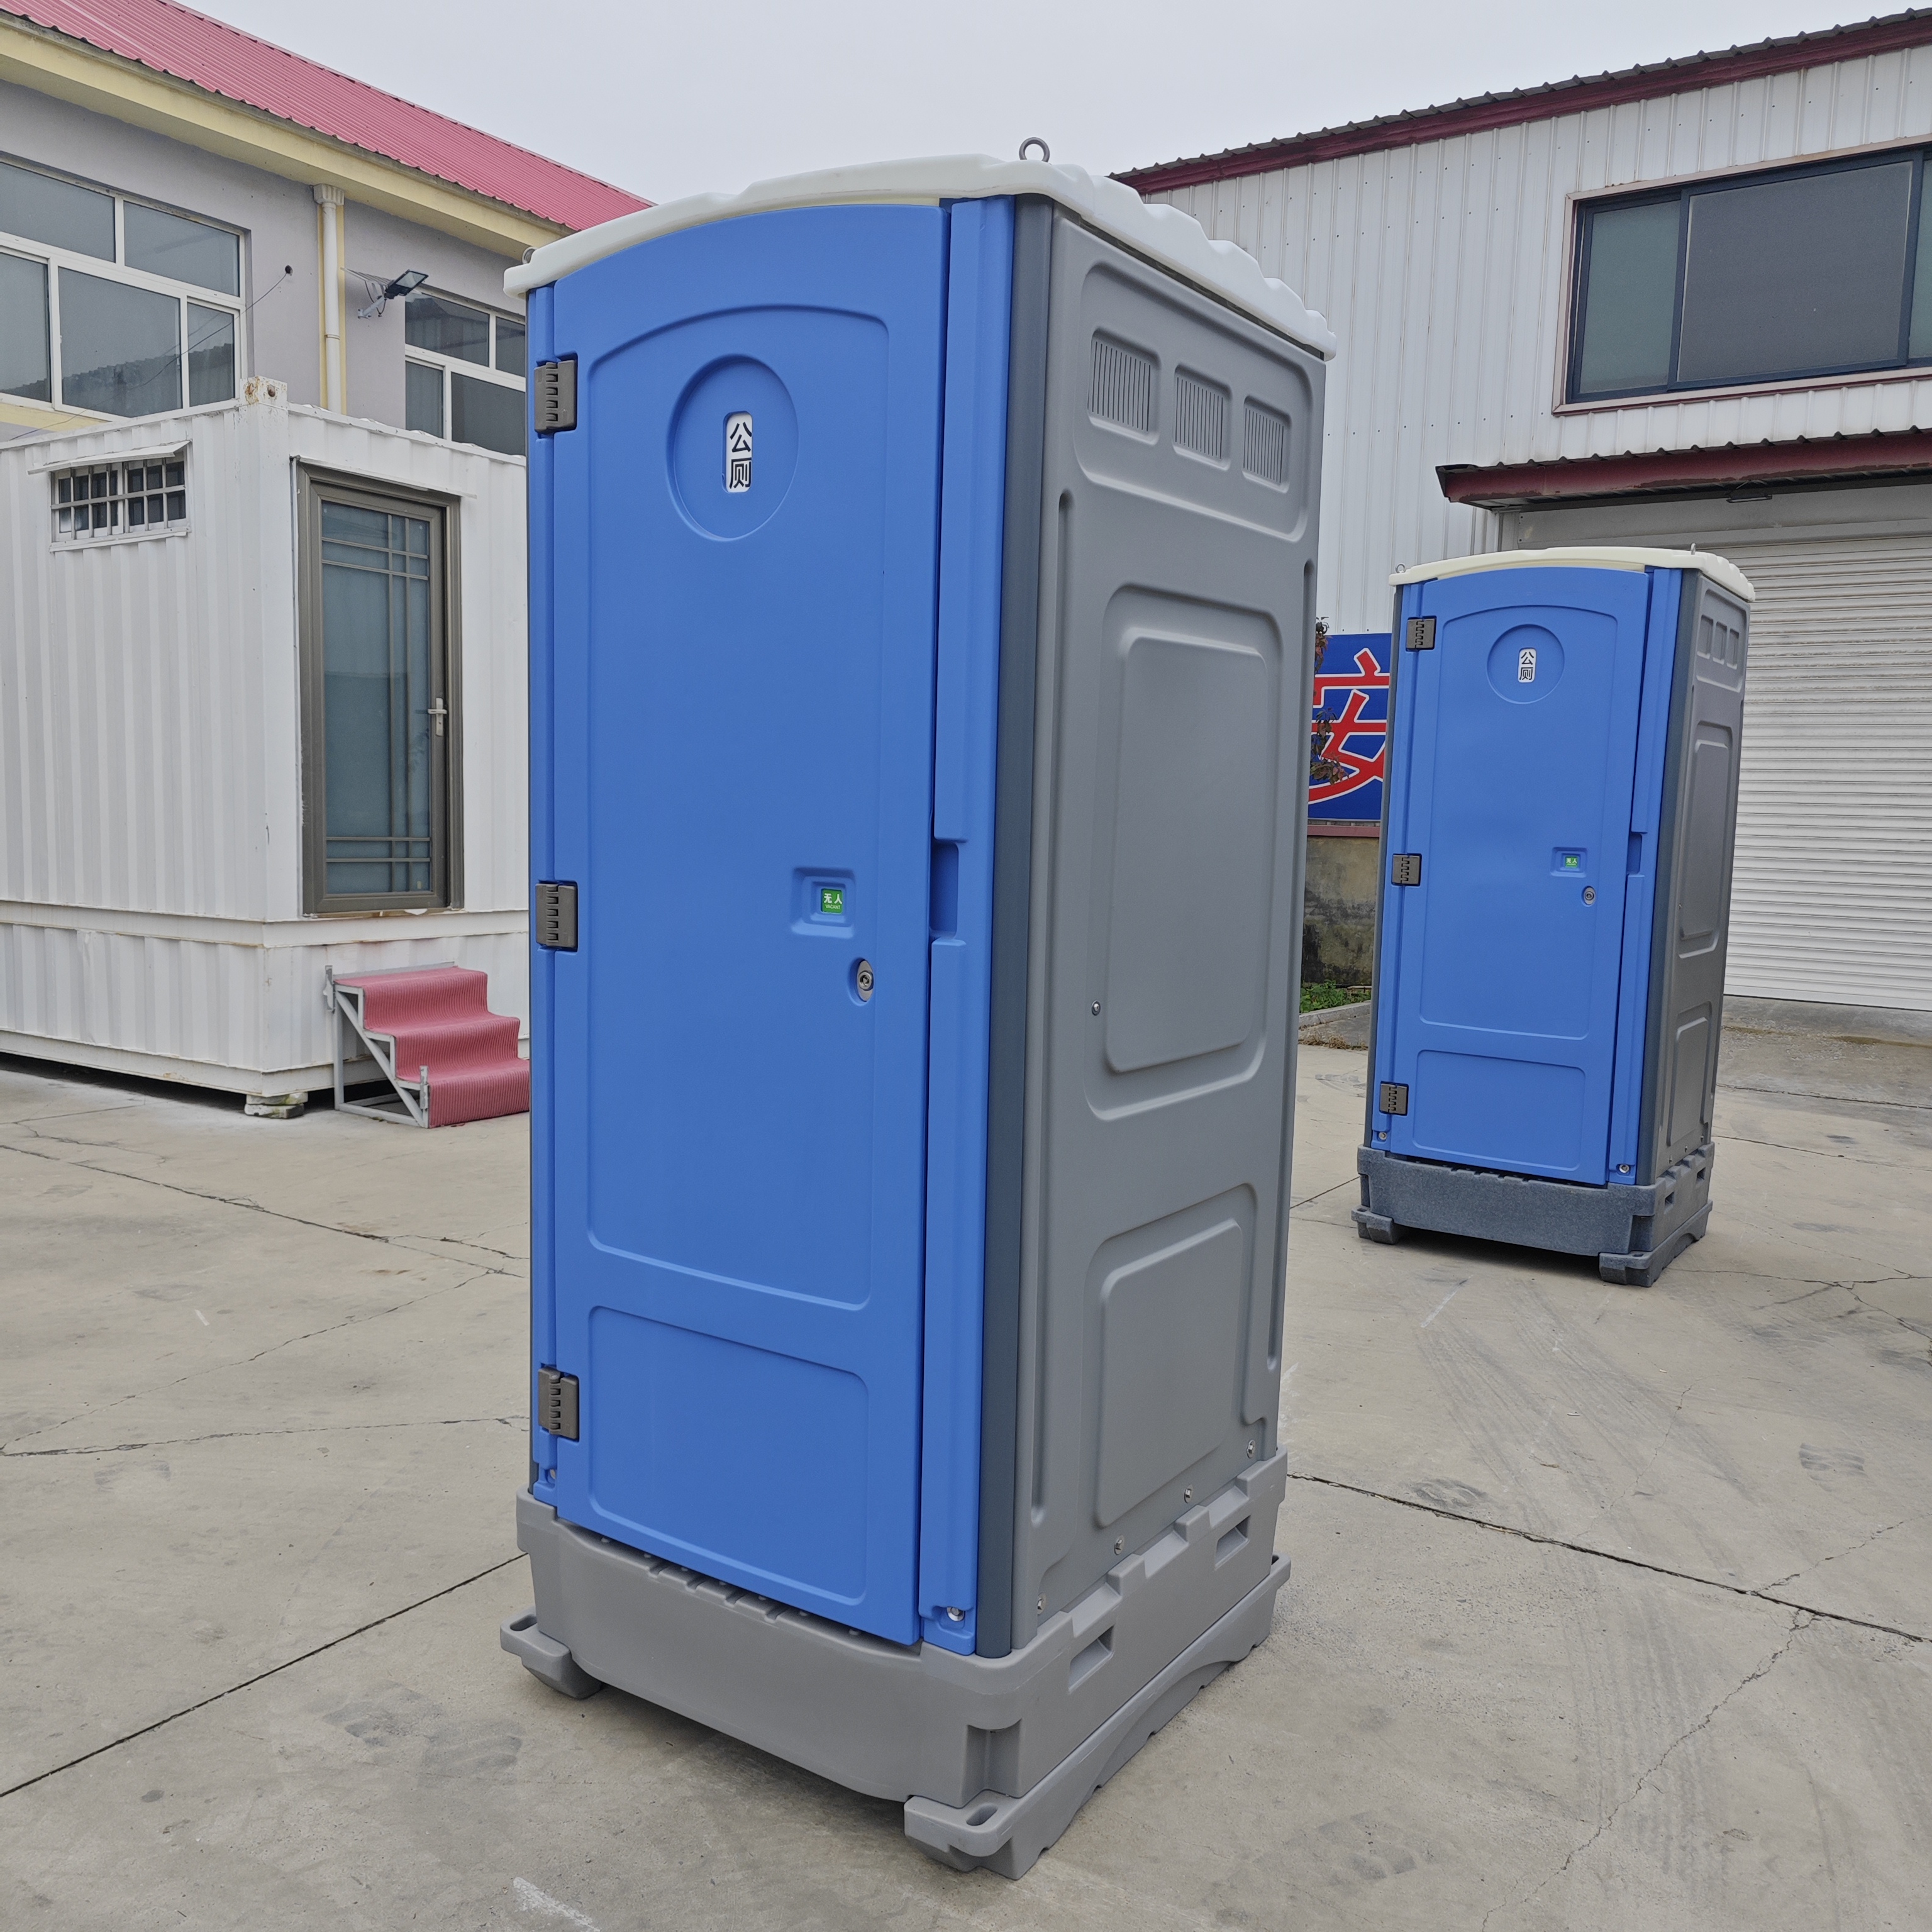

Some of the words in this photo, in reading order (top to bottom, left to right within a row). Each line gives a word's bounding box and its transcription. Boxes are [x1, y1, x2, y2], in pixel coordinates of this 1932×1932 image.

[730, 422, 752, 489] 公厕
[1519, 652, 1534, 680] 公厕
[824, 893, 843, 904] 无人
